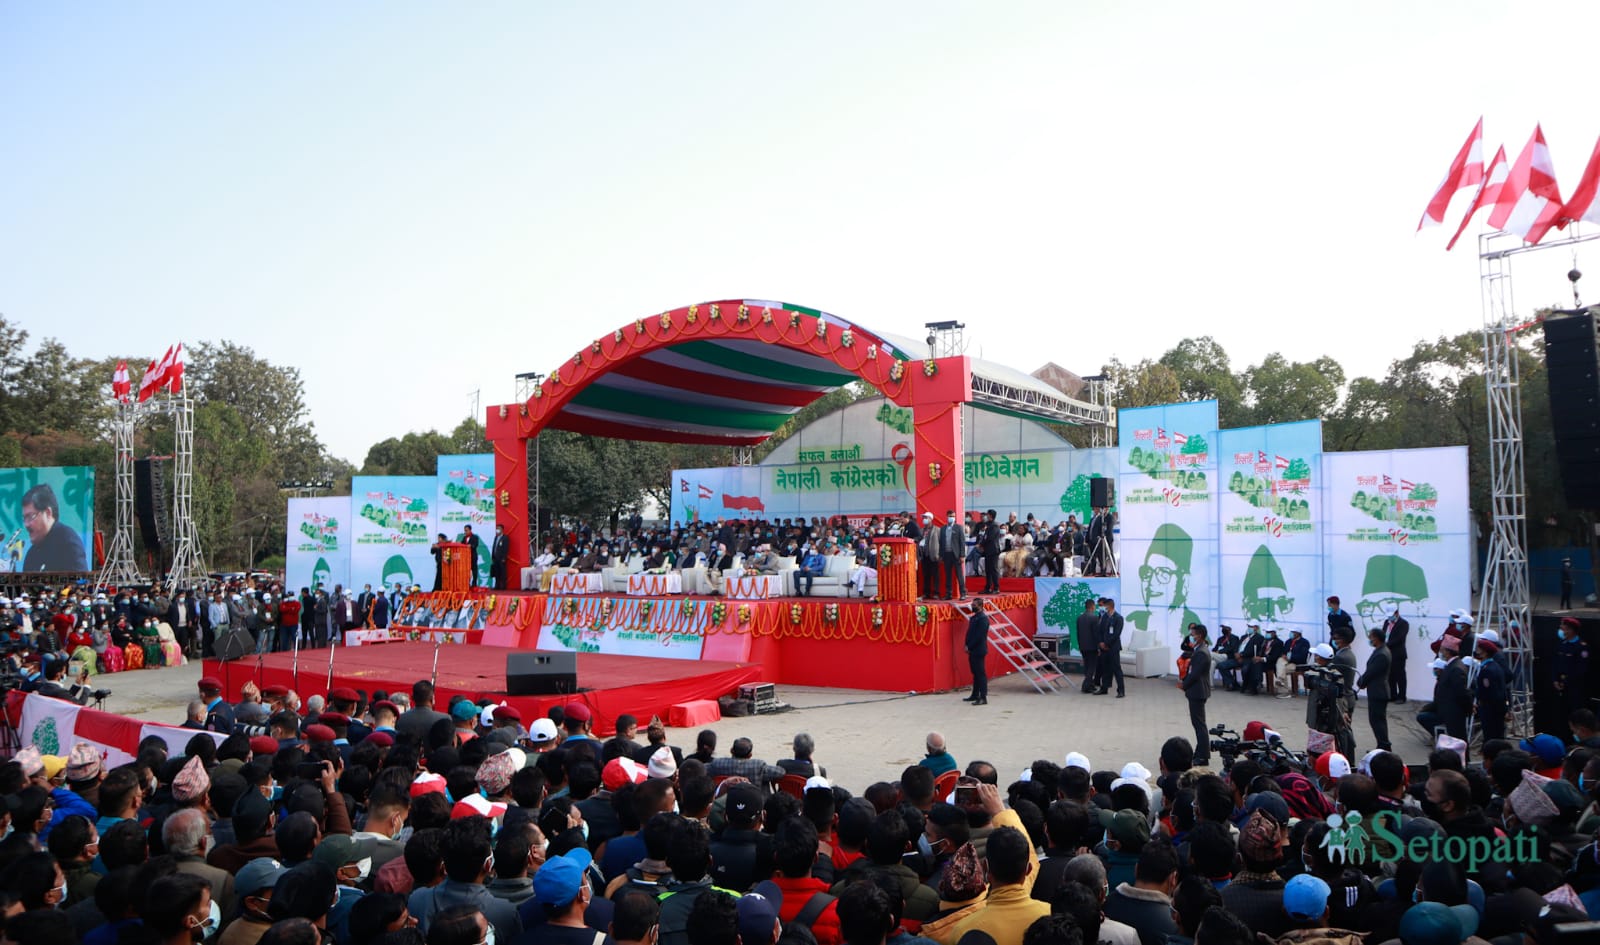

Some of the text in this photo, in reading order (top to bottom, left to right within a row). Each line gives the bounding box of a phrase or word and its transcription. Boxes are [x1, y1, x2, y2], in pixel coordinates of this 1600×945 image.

[776, 443, 1040, 499] नेपाली कांग्रेसको १ हाधिवेशन
[798, 450, 825, 463] सफल
